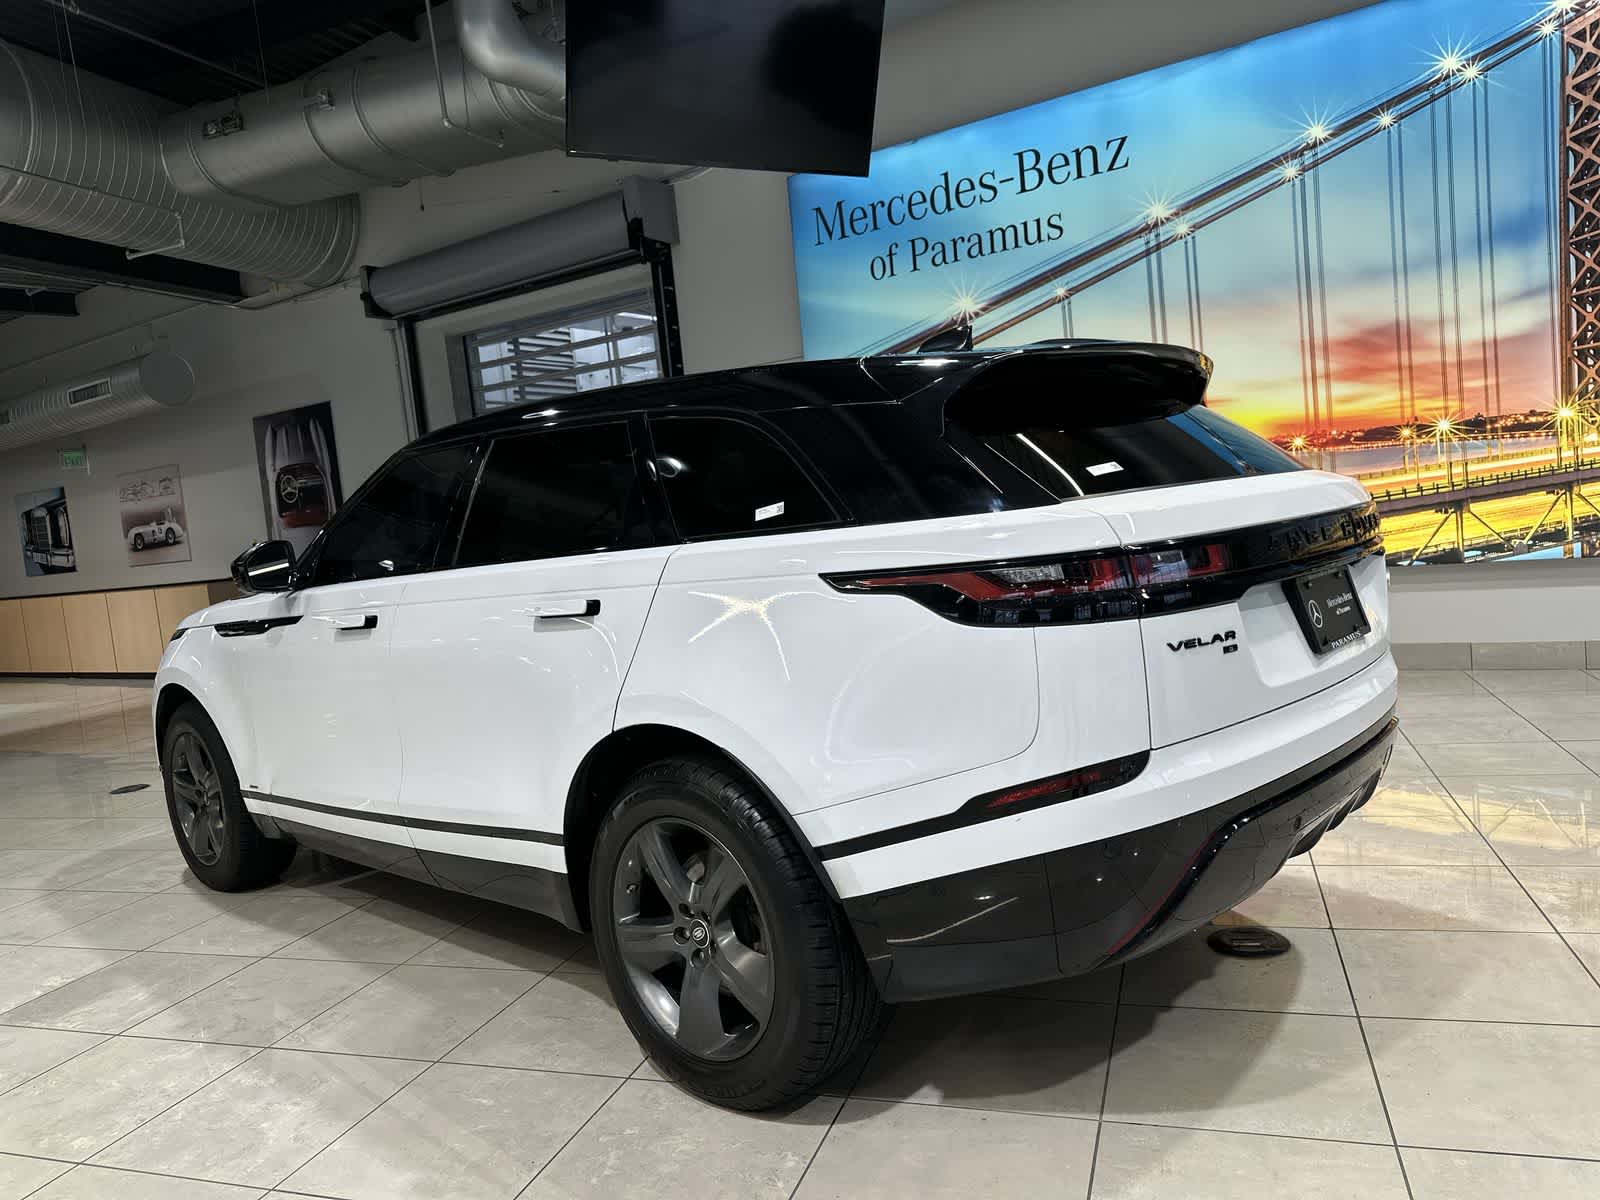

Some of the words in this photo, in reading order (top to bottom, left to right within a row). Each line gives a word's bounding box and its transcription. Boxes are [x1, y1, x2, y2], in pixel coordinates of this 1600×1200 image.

[812, 136, 1129, 246] Mercedes-Benz
[870, 242, 899, 281] of
[908, 211, 1064, 273] Paramus
[1166, 630, 1237, 652] VELAR
[1331, 630, 1361, 648] PARAMUS
